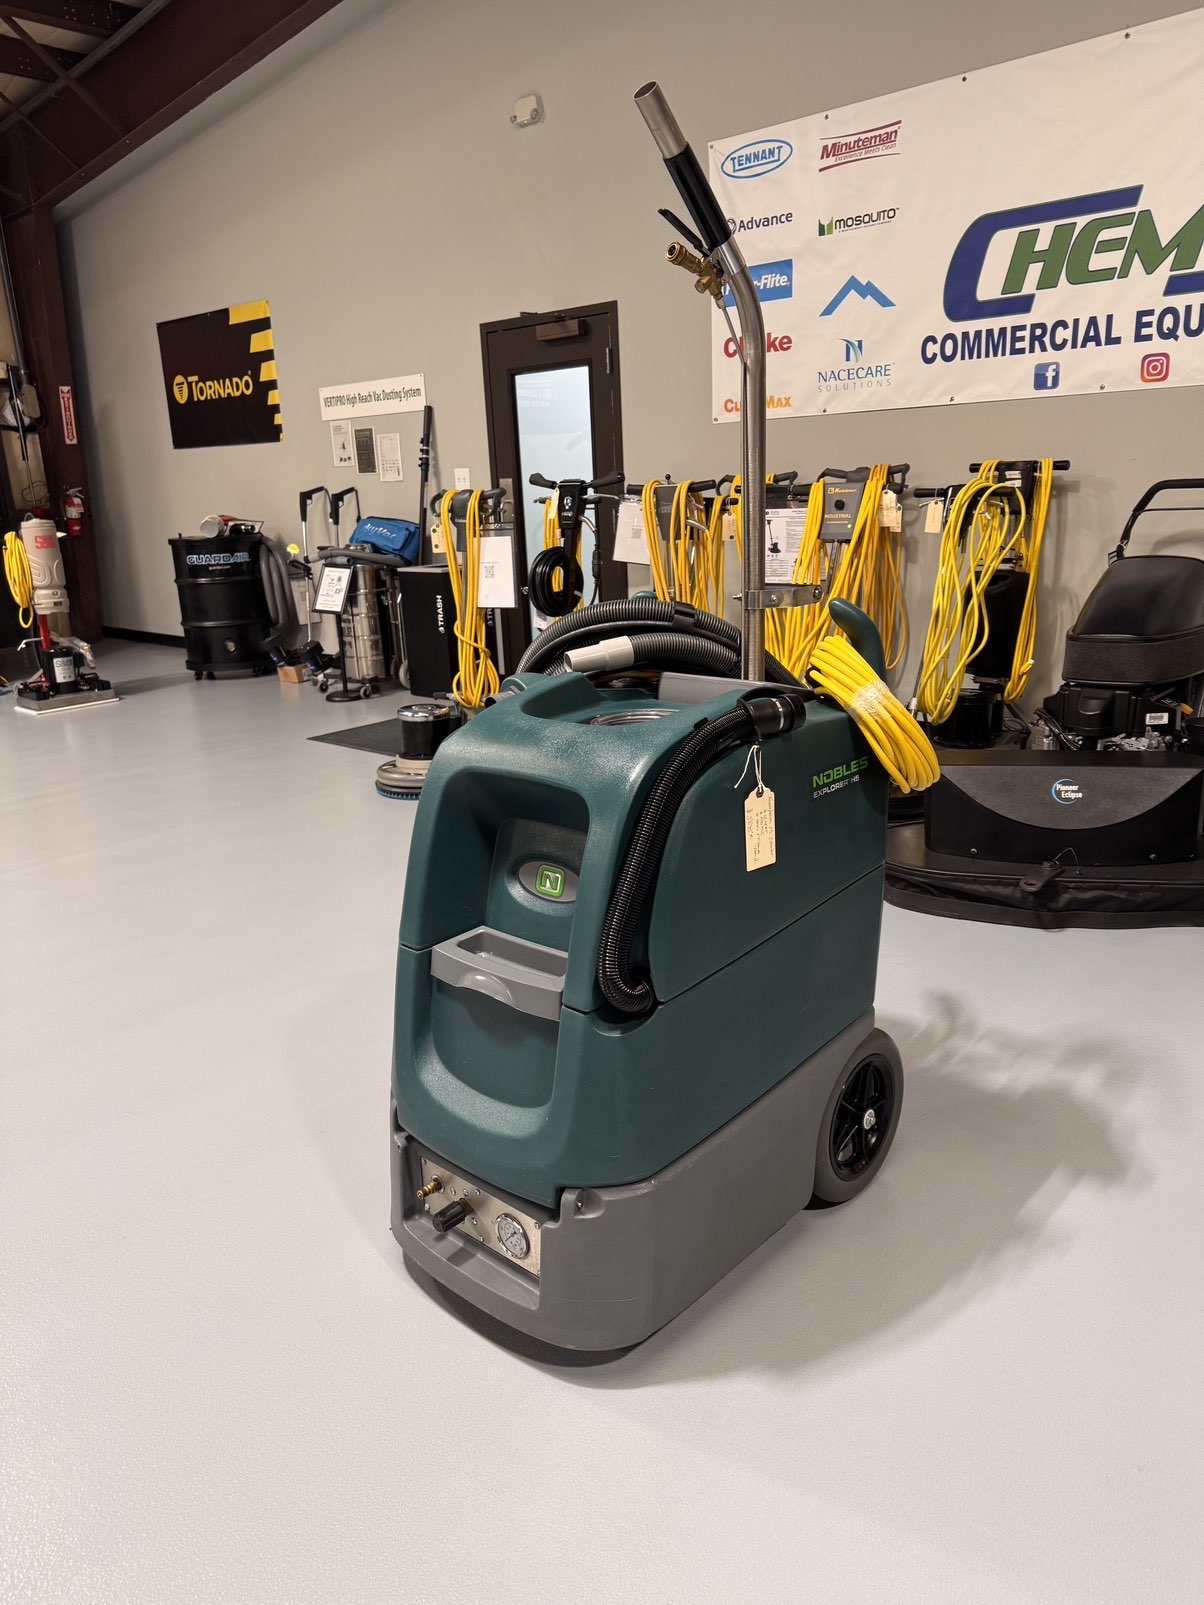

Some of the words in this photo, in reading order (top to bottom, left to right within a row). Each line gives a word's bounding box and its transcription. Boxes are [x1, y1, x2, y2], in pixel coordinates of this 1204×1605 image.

[820, 129, 898, 160] Minuteman
[730, 145, 784, 173] TENNANT
[738, 212, 793, 233] Advance
[920, 313, 1123, 365] COMMERCIAL
[817, 363, 893, 384] NACECARE
[817, 378, 893, 393] SOLUTIONS
[323, 394, 346, 408] VERTIPRO
[346, 393, 358, 407] High
[357, 391, 373, 403] Reach
[372, 390, 382, 402] Vac
[382, 388, 402, 402] Dusting
[402, 386, 422, 401] System
[186, 551, 251, 565] GUARDAIR
[436, 594, 445, 627] TRASH
[812, 755, 869, 789] NOBLES
[813, 779, 849, 799] EXPLORER
[1056, 783, 1079, 791] Pioneer
[1061, 790, 1083, 800] Eclipse
